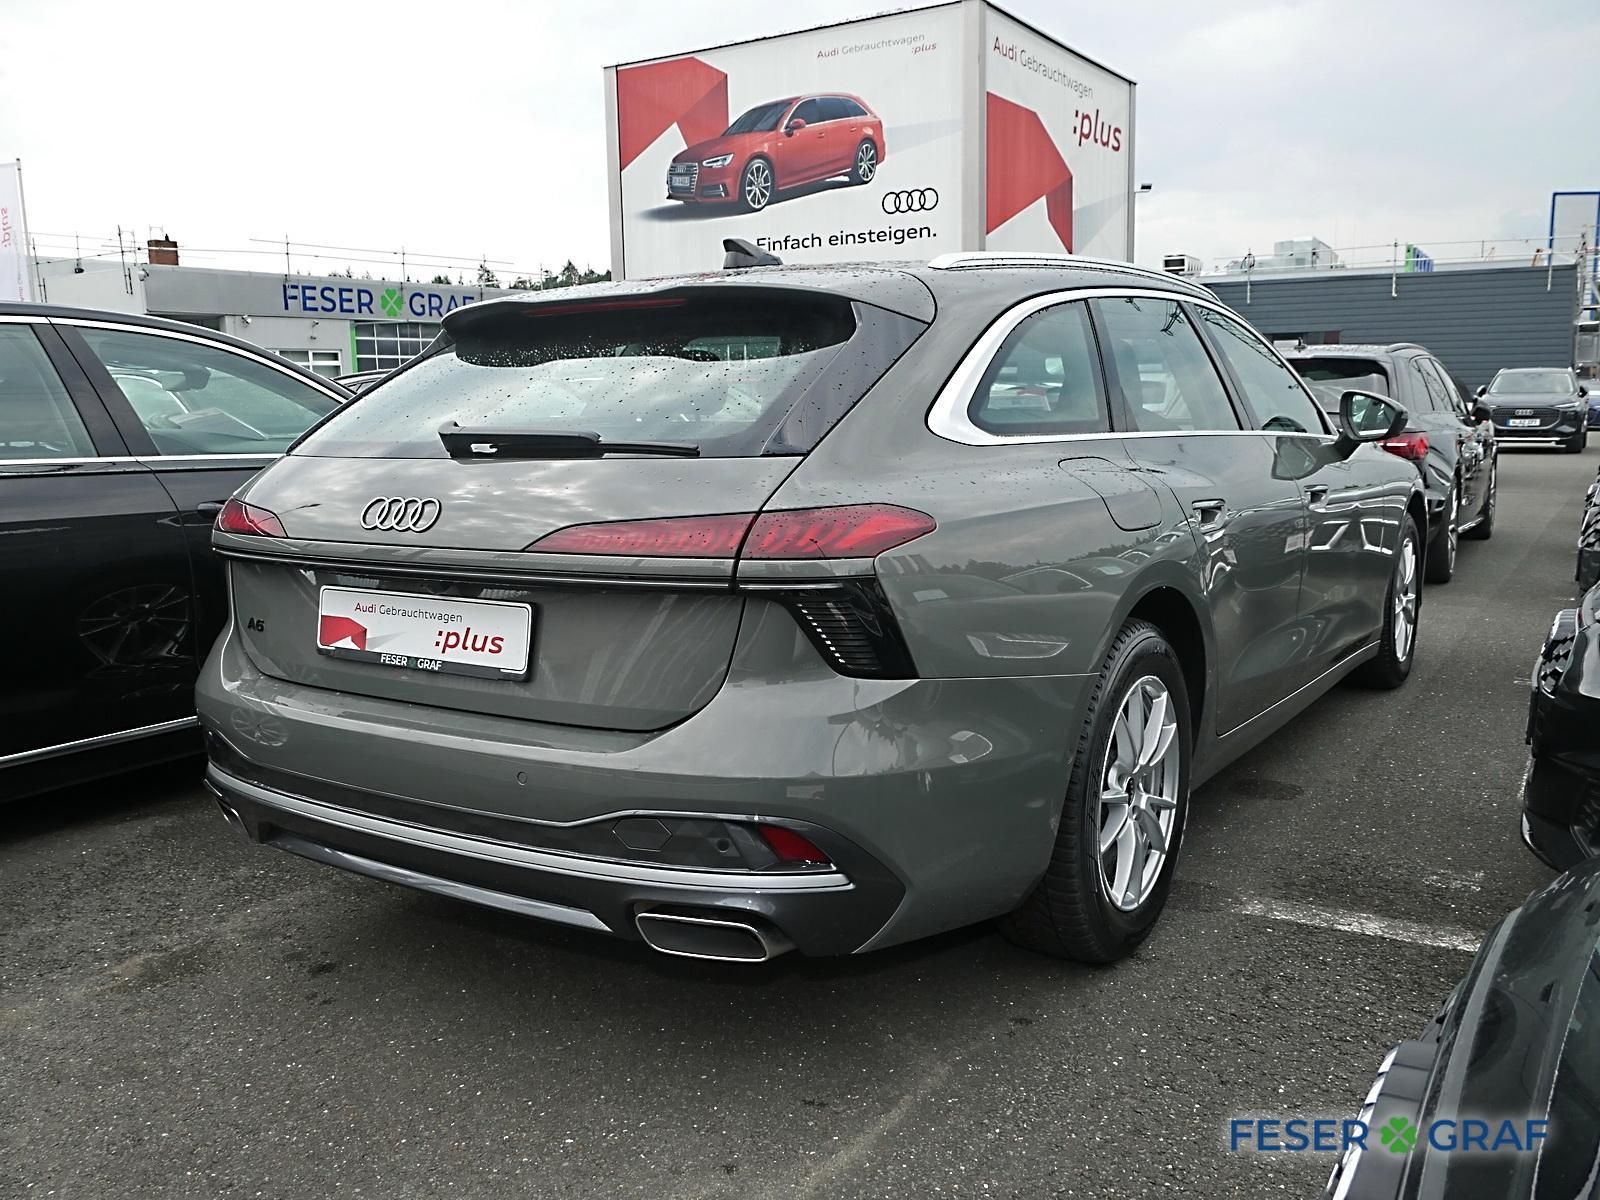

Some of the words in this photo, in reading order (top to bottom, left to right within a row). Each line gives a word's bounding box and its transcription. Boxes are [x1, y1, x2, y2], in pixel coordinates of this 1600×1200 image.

[817, 48, 839, 58] Audi
[841, 34, 925, 55] Gebrauchtwagen
[911, 42, 937, 54] :plus
[993, 36, 1018, 62] Audi
[1020, 49, 1094, 99] Gebrauchtwagen
[1073, 108, 1122, 152] :plus
[756, 234, 822, 252] Einfach
[828, 225, 937, 246] einsteigen.
[283, 283, 374, 314] FESER
[247, 616, 265, 632] A6
[354, 602, 377, 614] Audi
[379, 604, 463, 623] Gebrauchtwagen
[434, 627, 505, 655] :plus
[380, 653, 408, 667] FESER
[417, 658, 443, 671] GRAF
